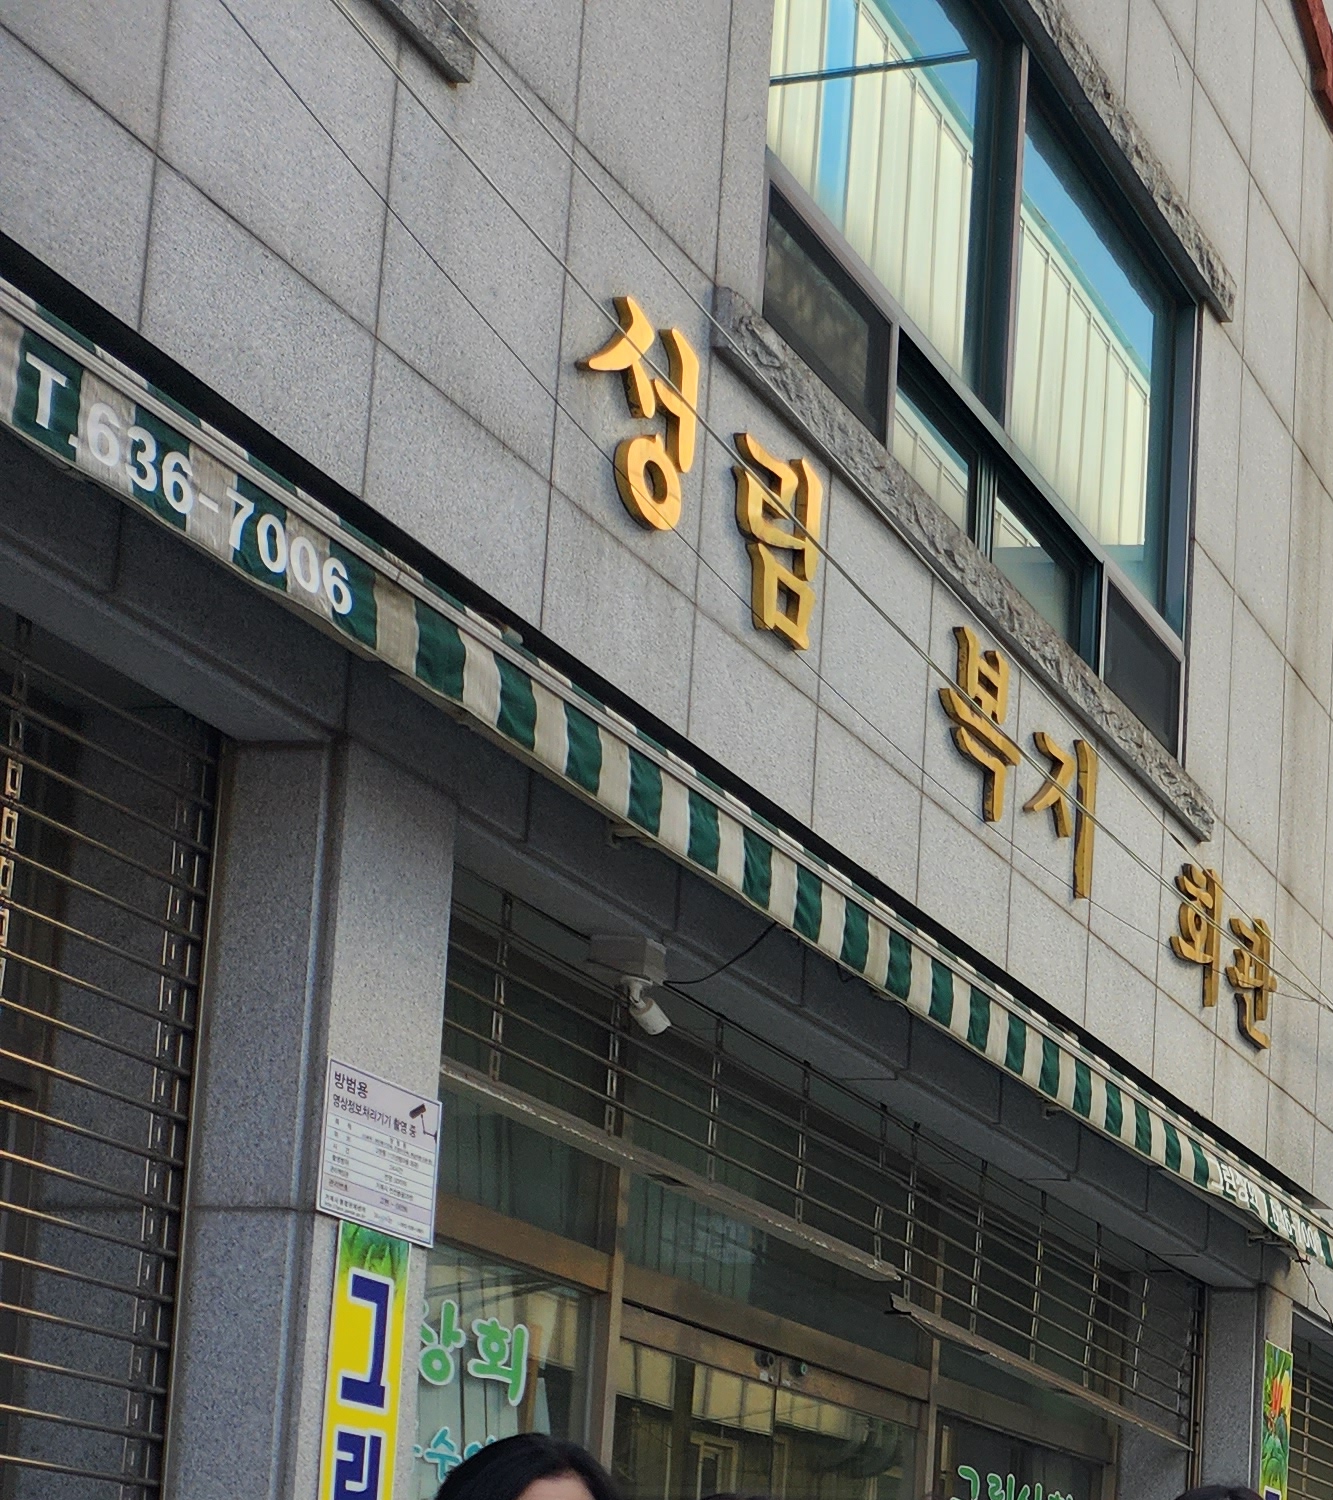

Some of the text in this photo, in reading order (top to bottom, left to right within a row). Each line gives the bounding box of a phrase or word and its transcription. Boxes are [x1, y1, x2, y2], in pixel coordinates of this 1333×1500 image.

[939, 626, 1097, 900] 복지
[1170, 862, 1278, 1050] 회관
[334, 1071, 369, 1099] 방범용
